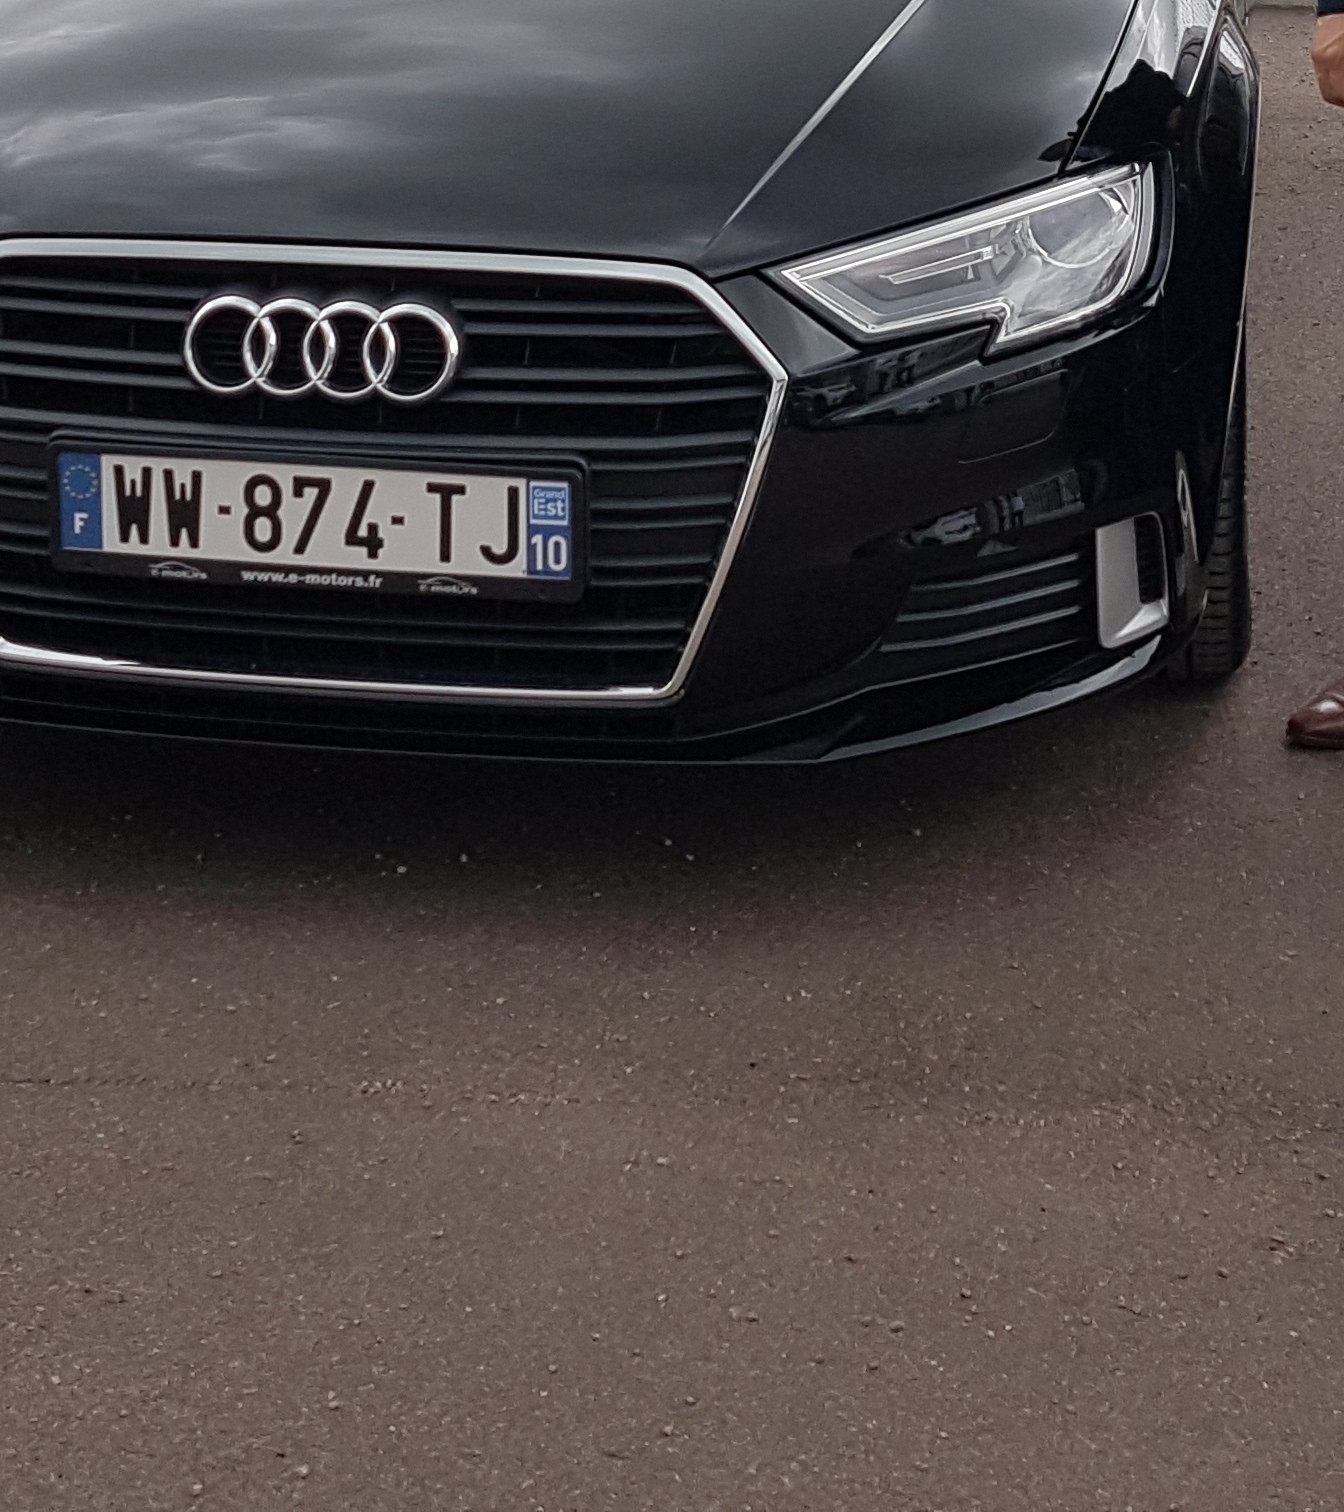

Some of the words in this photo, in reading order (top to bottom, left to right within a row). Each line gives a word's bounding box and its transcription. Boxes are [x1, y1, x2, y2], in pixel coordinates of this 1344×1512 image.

[533, 488, 565, 499] Grand
[533, 498, 565, 517] Est
[73, 512, 89, 535] F
[530, 533, 568, 572] 10
[240, 569, 384, 589] www.e-motors.fr
